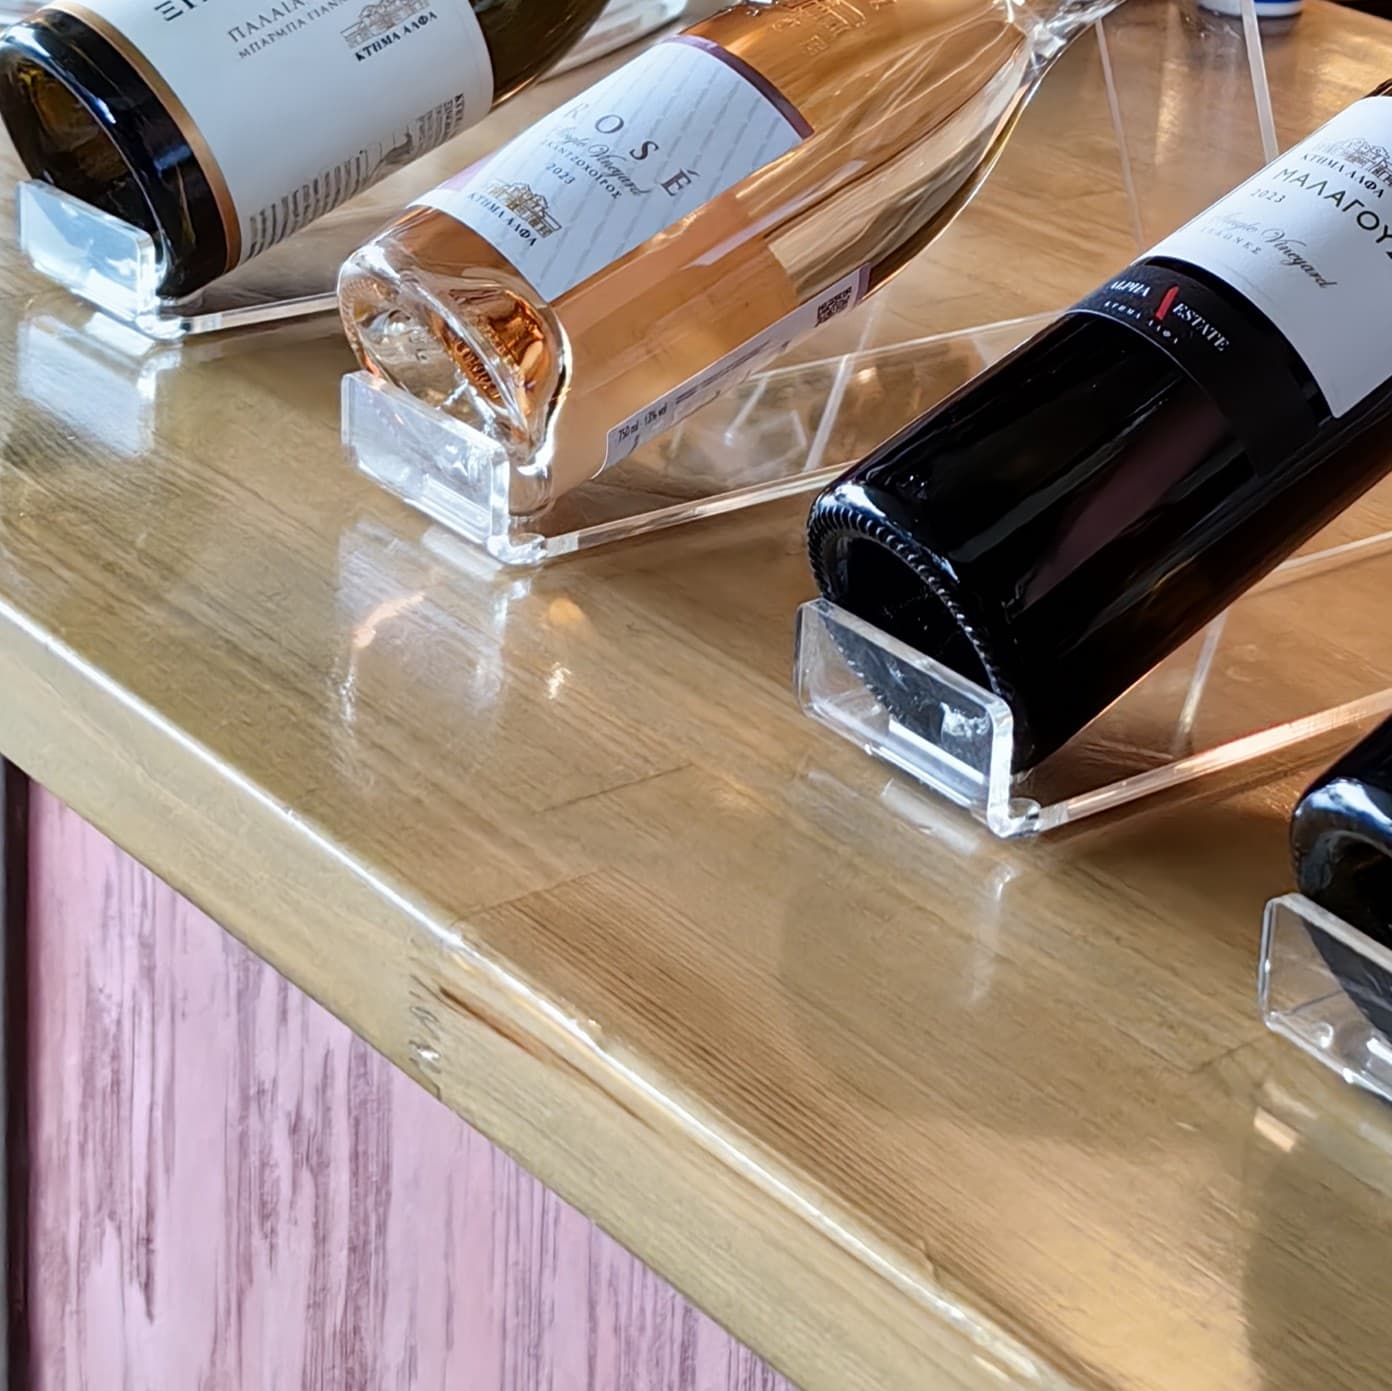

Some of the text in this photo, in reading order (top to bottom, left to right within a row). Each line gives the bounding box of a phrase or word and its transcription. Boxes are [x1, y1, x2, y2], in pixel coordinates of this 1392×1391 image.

[239, 18, 309, 59] ΜΠΑΡΜΠΑ
[354, 11, 438, 62] ΚΤΗΜΑ ΑΛΦΑ
[546, 163, 576, 185] 2023
[588, 144, 653, 196] Vineyard
[1302, 153, 1385, 199] ΚΤΗΜΑ ΑΛΦΑ
[1250, 188, 1286, 203] 2023
[506, 217, 537, 246] ΑΛΦΑ
[1261, 228, 1338, 289] Vineyard
[1173, 303, 1229, 351] ESTATE
